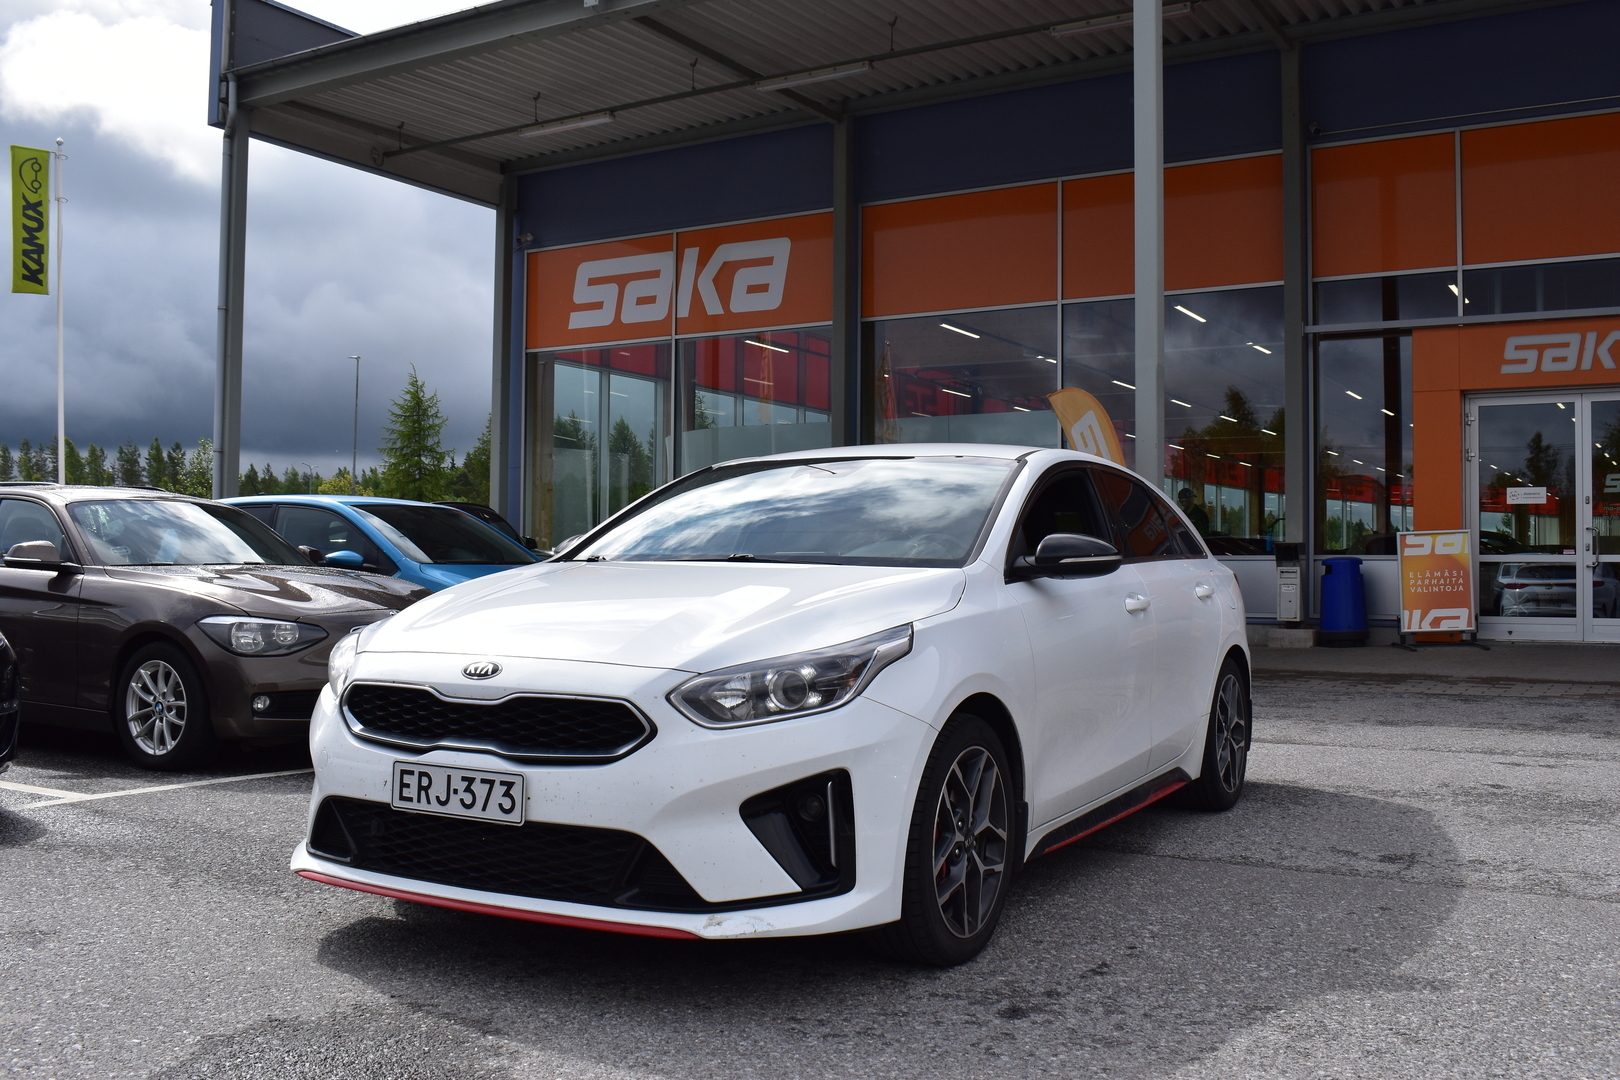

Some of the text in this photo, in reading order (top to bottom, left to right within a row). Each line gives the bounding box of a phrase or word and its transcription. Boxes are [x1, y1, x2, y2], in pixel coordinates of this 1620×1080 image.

[21, 192, 44, 287] KAMUX
[1501, 330, 1620, 374] sak
[1409, 569, 1464, 578] ELÄMÄSI
[1409, 578, 1464, 586] PARHAITA
[1410, 585, 1464, 593] VALINTOJA
[466, 664, 493, 675] KIA
[398, 768, 516, 815] ERJ-373
